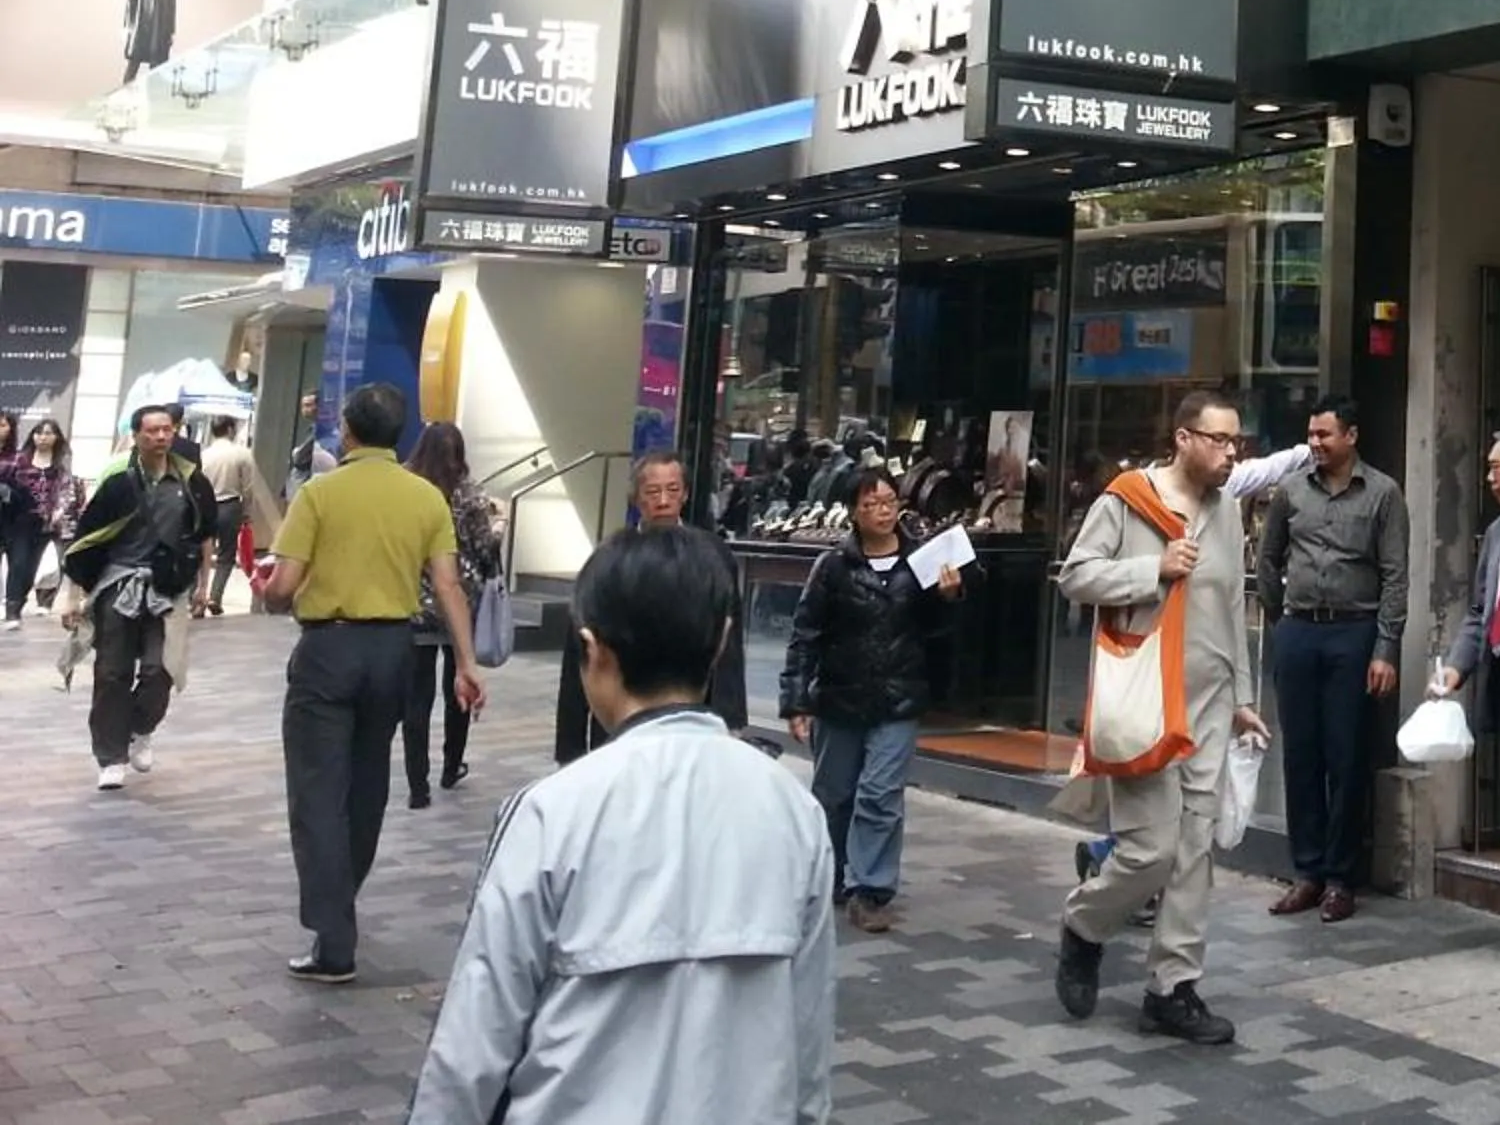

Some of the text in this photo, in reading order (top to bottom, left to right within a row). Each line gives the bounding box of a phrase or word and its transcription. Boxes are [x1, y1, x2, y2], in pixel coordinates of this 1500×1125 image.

[463, 13, 600, 83] 六福
[1028, 35, 1204, 73] lukfook.com.hk
[460, 77, 593, 111] LUKFOOK
[836, 57, 967, 132] LUKFOOK
[1017, 91, 1212, 132] 六福珠寶 LUKFOOK
[1136, 122, 1212, 141] JEWELLERY
[451, 180, 587, 200] lukfook.com.hk
[0, 205, 86, 243] ma
[357, 179, 411, 260] citib
